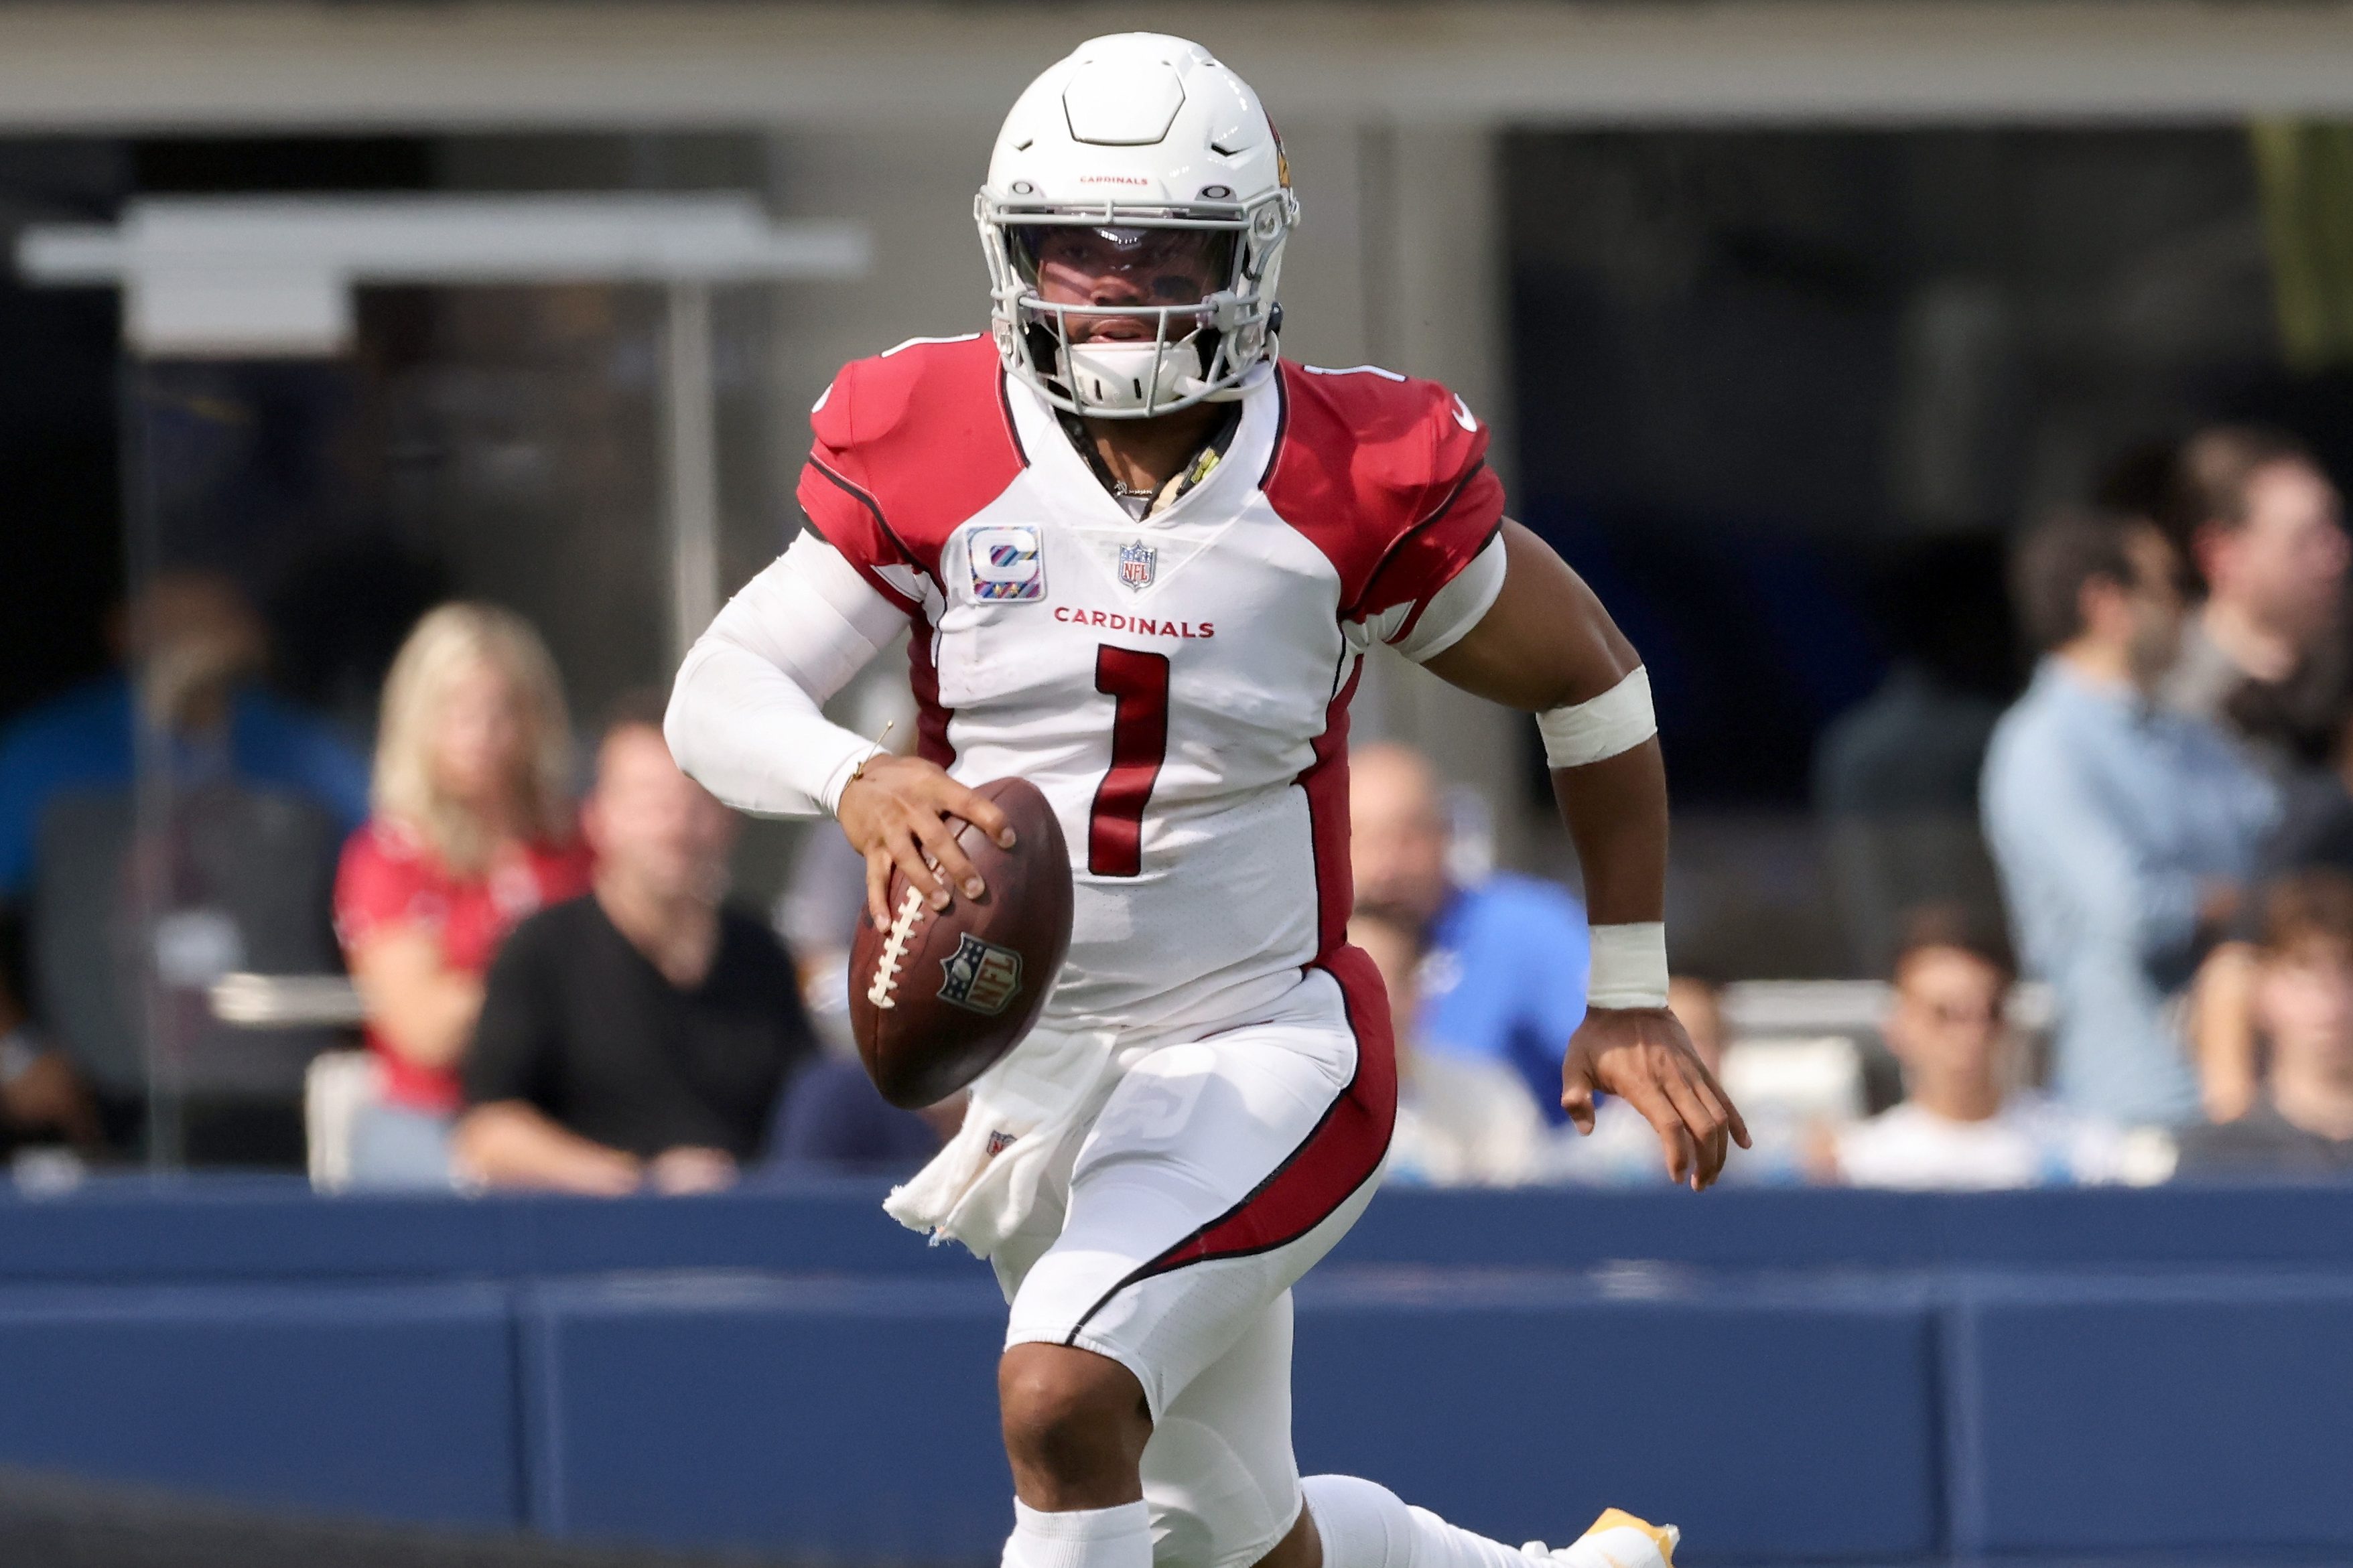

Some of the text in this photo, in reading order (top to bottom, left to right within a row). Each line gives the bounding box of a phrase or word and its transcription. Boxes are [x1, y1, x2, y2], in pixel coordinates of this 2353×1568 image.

[1079, 175, 1148, 186] CARDINALS
[1123, 562, 1148, 582] NFL
[1054, 606, 1215, 638] CARDINALS
[1088, 643, 1170, 877] 1
[967, 956, 1016, 1007] NFL
